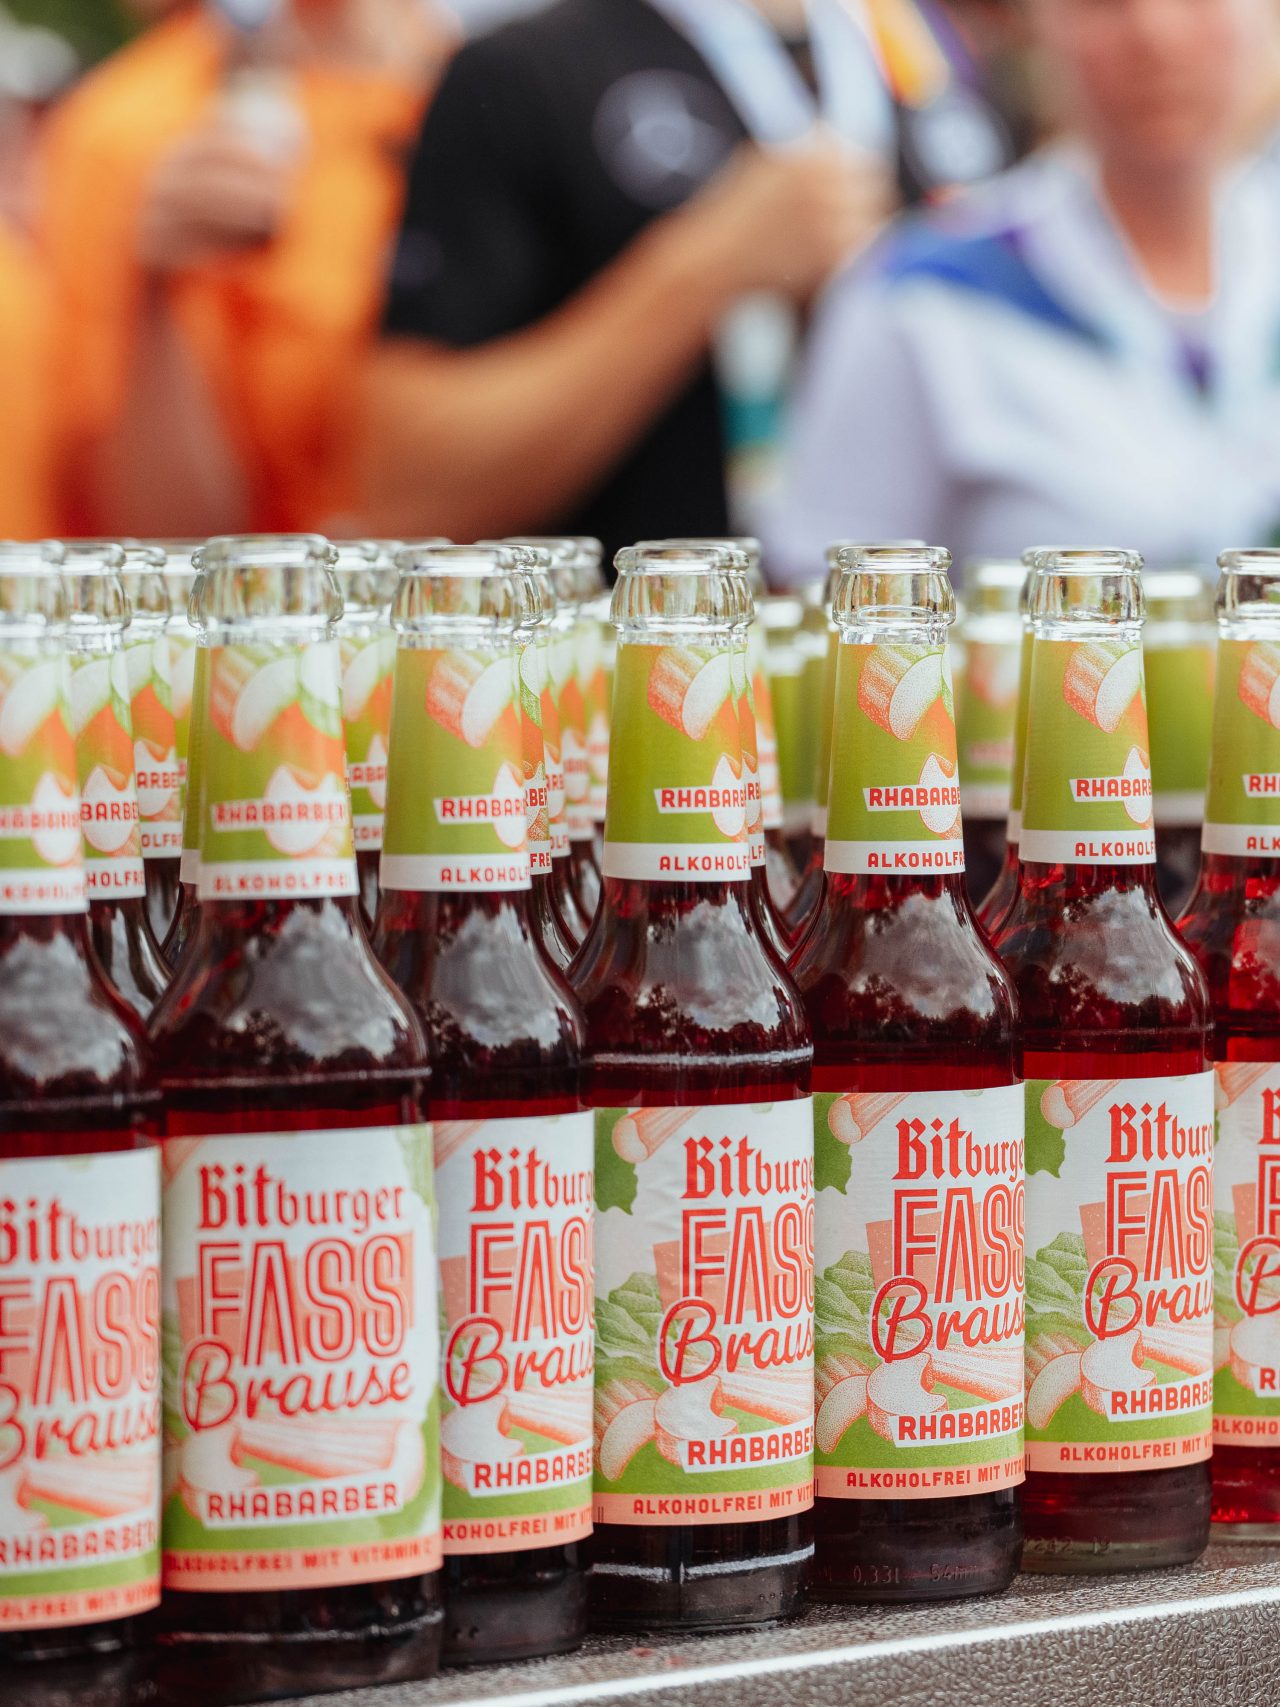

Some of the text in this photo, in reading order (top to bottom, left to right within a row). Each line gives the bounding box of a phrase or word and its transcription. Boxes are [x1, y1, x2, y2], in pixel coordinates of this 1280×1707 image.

[199, 1164, 405, 1235] Bitburger
[894, 1180, 1024, 1304] FASS
[1106, 1164, 1214, 1281] FAS
[197, 1234, 405, 1367] FASS
[470, 1216, 594, 1342] FAS
[182, 1340, 415, 1432] Brause
[660, 1299, 814, 1387] Braus
[847, 1470, 971, 1488] ALKOHOLFREI
[978, 1465, 1001, 1483] MIT
[1060, 1442, 1176, 1461] ALKOHOLFREI
[1182, 1437, 1201, 1454] MIT
[208, 1482, 398, 1520] RHABARBER
[633, 1495, 762, 1514] ALKOHOLFREI
[769, 1490, 793, 1508] MIT
